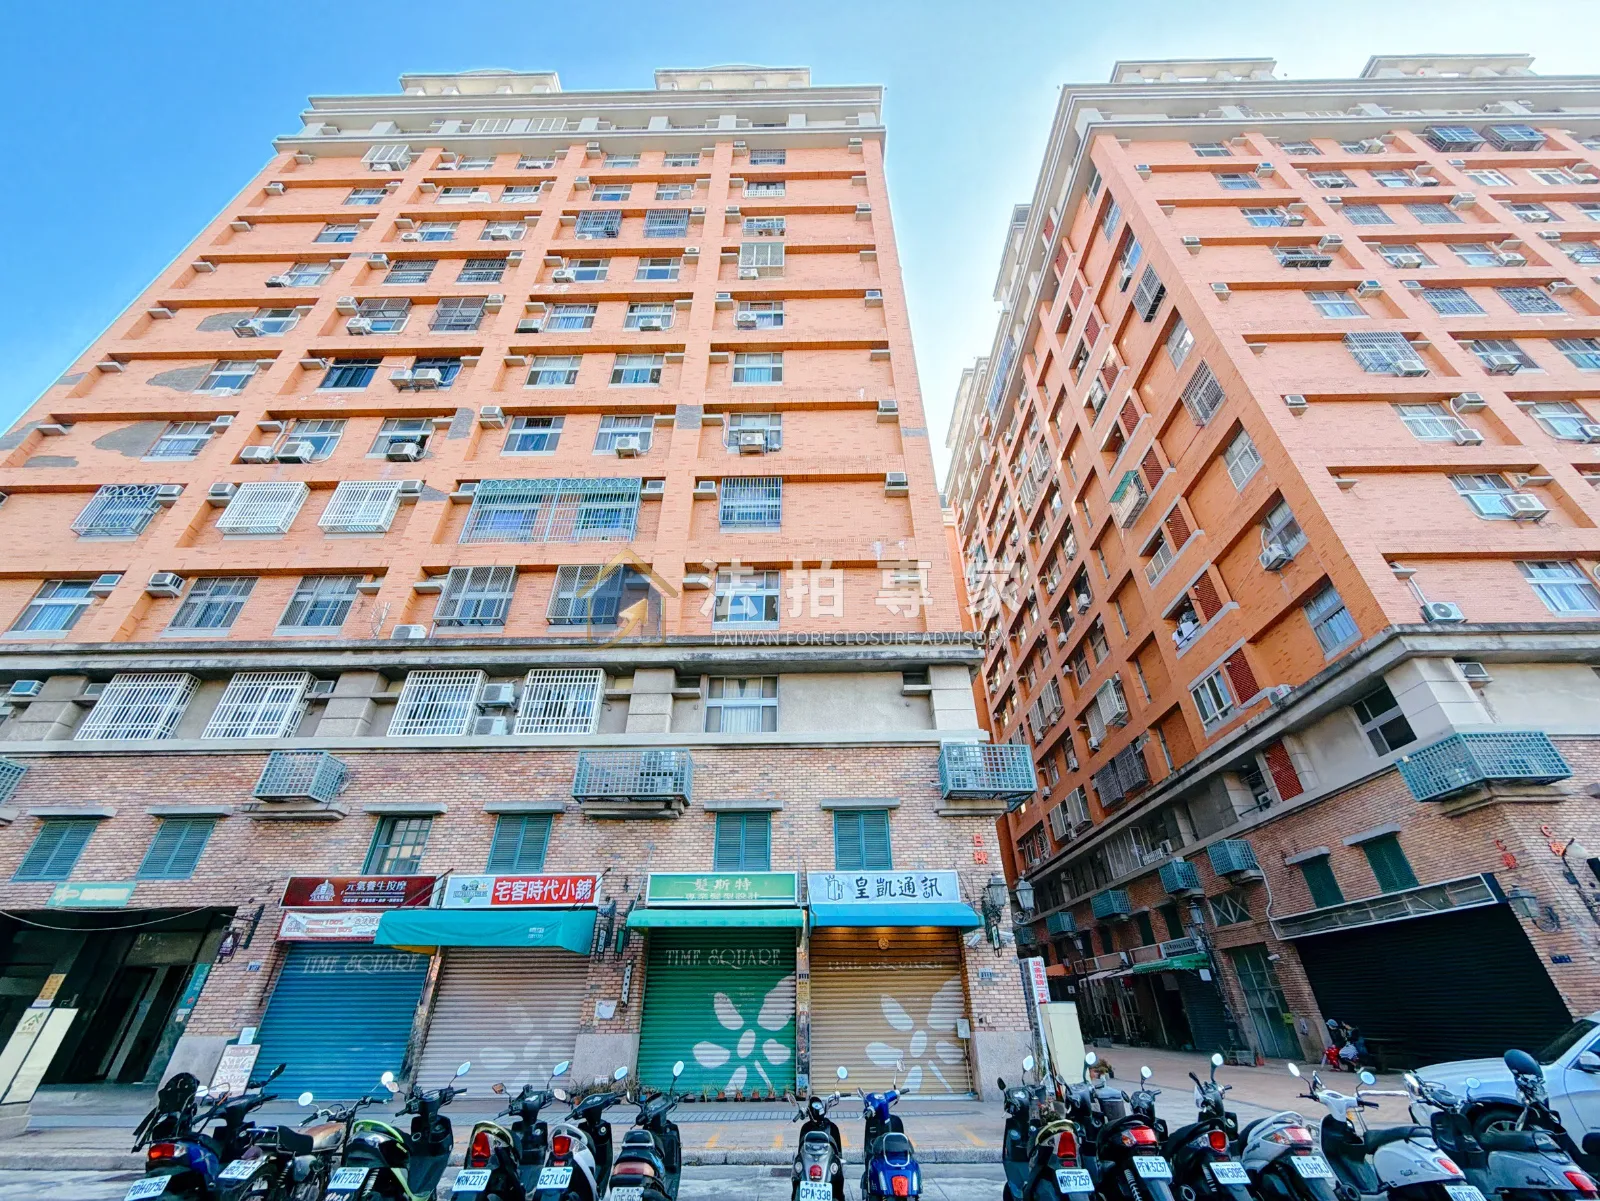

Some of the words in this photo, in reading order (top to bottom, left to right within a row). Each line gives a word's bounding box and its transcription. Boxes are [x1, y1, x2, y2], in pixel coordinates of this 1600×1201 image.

[855, 876, 943, 899] 皇凱通訊
[303, 955, 341, 974] TIME
[665, 949, 701, 966] TIME
[708, 948, 781, 970] SQUARE
[456, 1172, 488, 1187] MRN-2219
[800, 1187, 831, 1201] CPA-338
